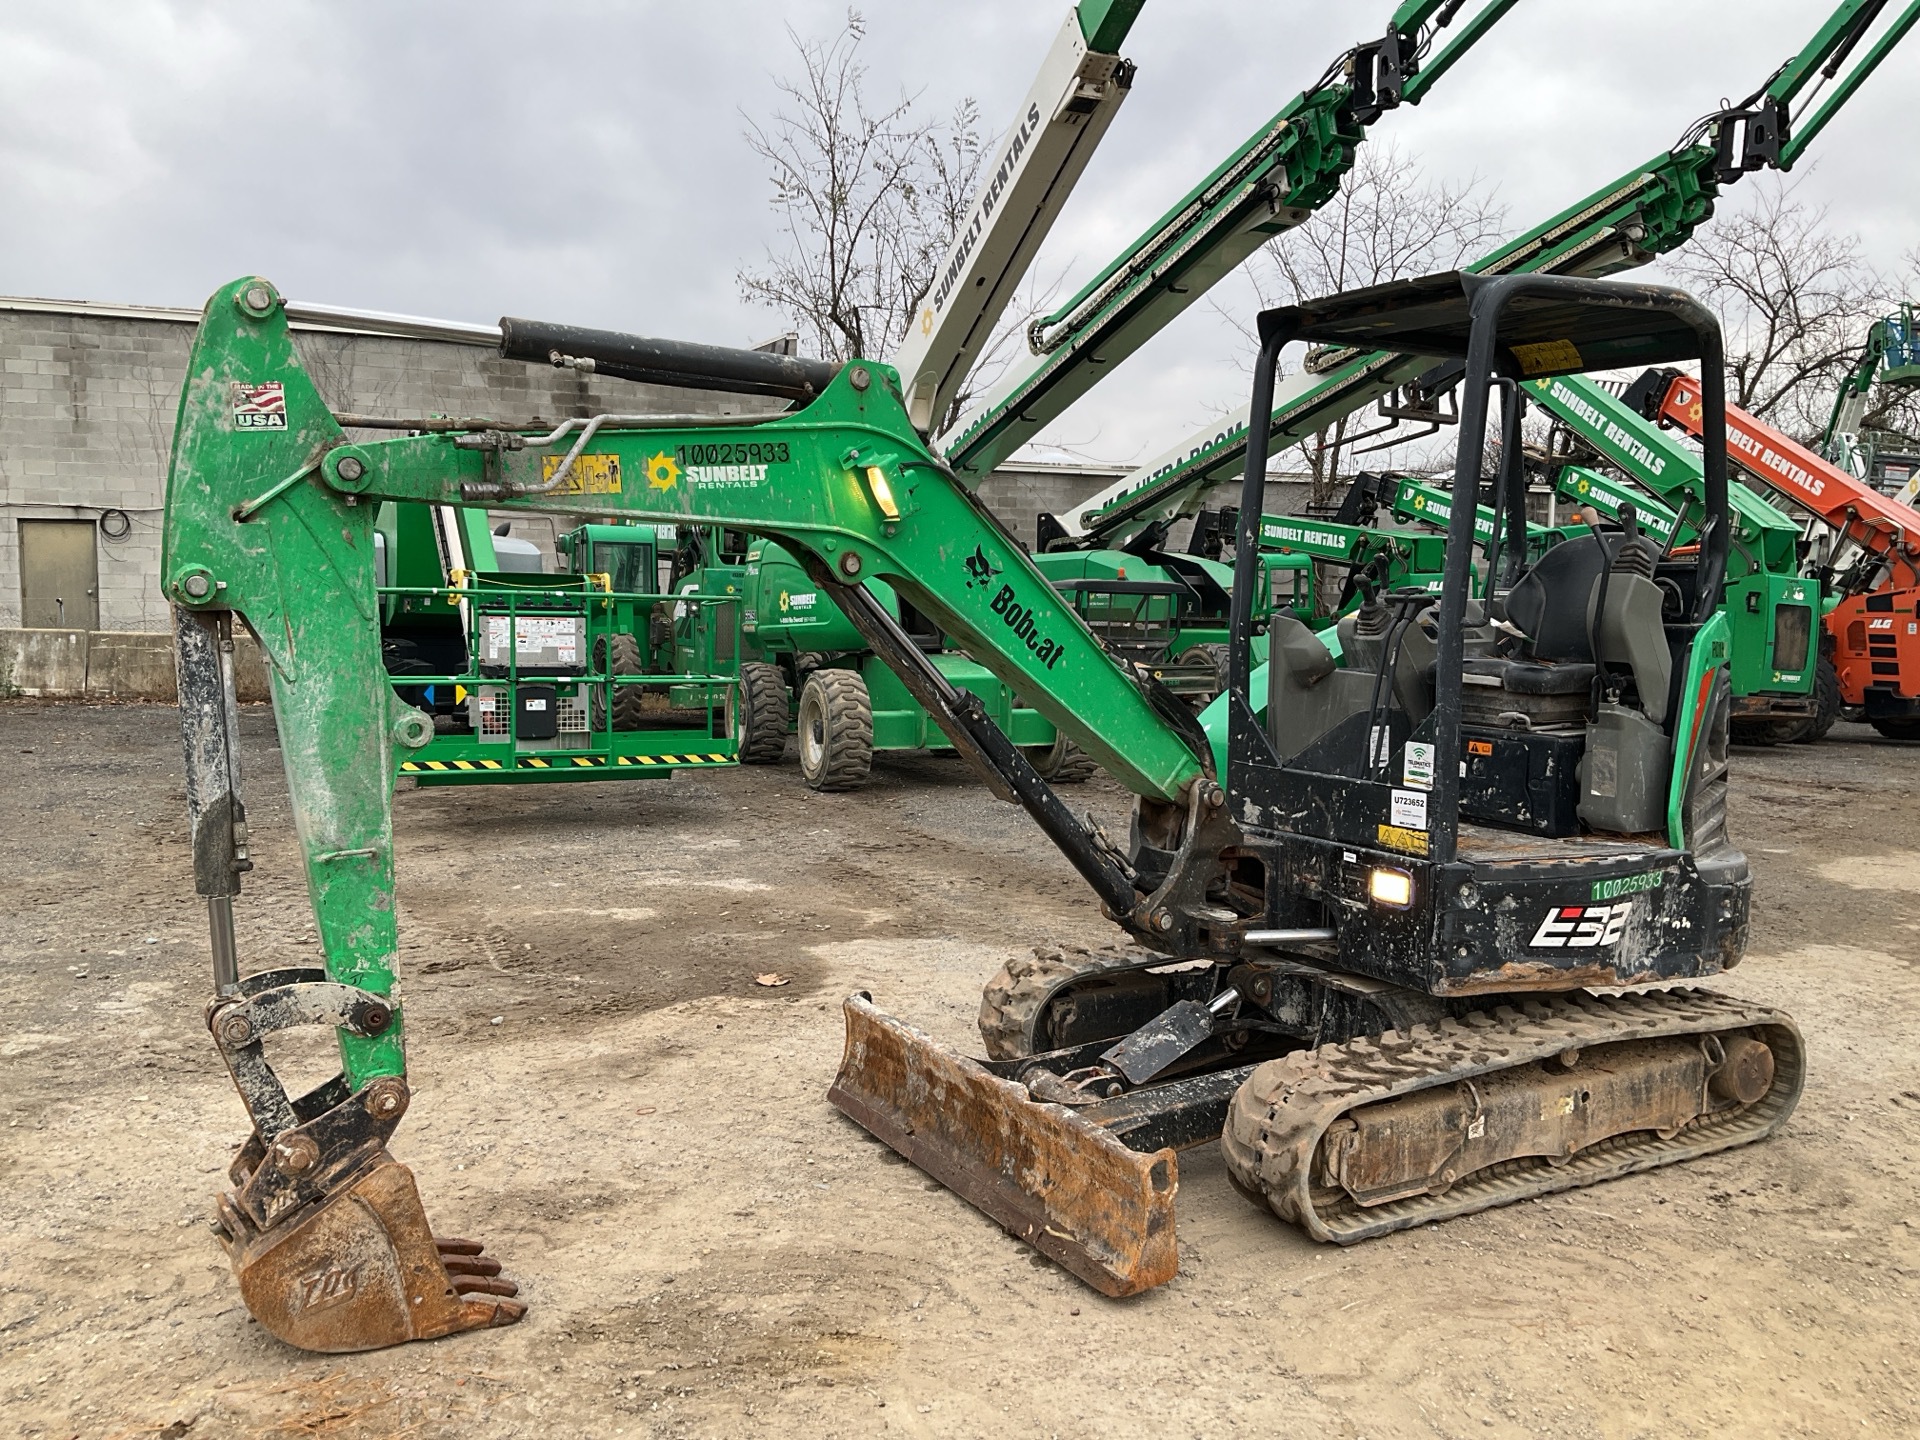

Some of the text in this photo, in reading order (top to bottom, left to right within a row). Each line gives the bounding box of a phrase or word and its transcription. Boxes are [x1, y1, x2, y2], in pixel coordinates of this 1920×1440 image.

[934, 102, 1040, 313] SUNBELT RENTALS
[237, 414, 283, 426] USA
[1550, 381, 1666, 476] SUNBELT RENTALS
[677, 442, 790, 466] 10025933
[686, 465, 768, 483] SUNBELT
[698, 481, 758, 489] RENTALS
[1760, 448, 1826, 497] RENTALS
[1264, 524, 1346, 549] SUNBELT RENTALS
[790, 593, 817, 606] SUNBELT
[990, 583, 1065, 671] Bobcat
[1868, 618, 1893, 629] JLG
[1593, 871, 1663, 900] 10025933
[1528, 901, 1634, 948] E32
